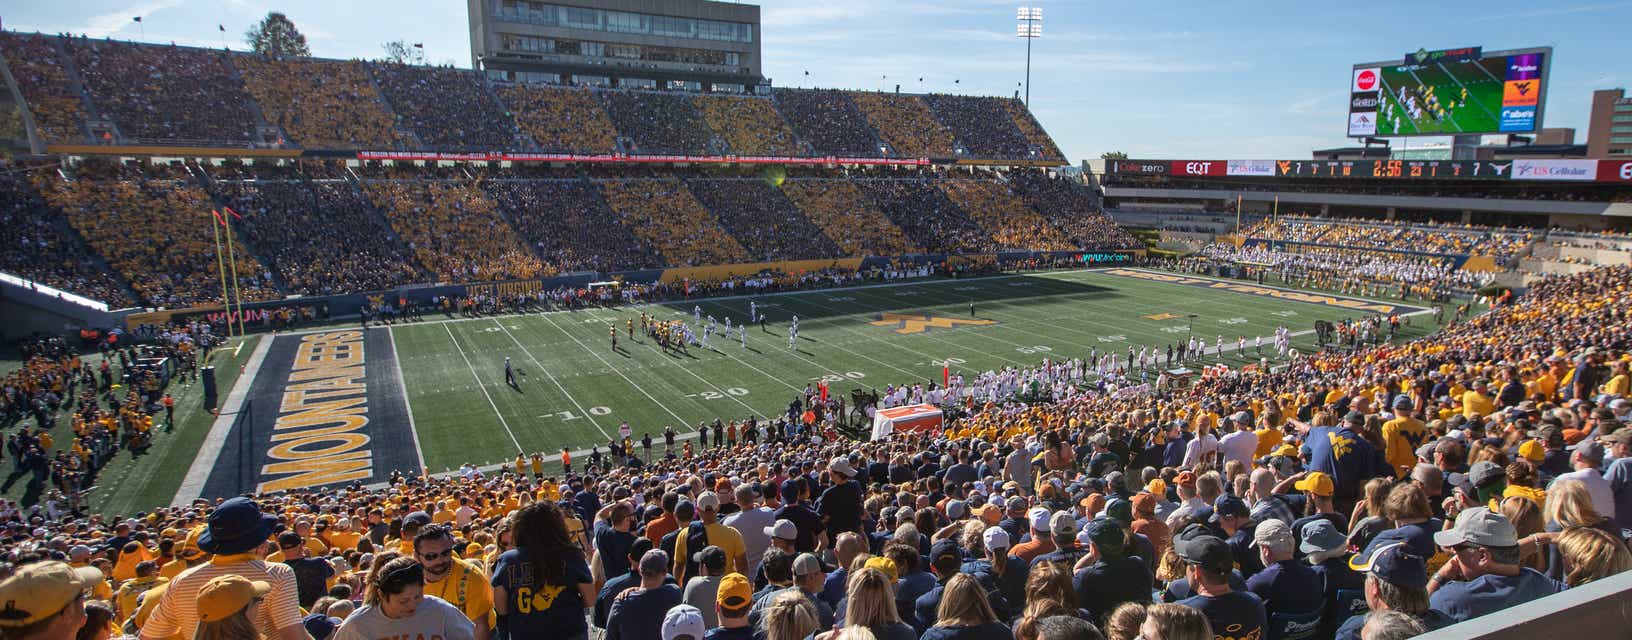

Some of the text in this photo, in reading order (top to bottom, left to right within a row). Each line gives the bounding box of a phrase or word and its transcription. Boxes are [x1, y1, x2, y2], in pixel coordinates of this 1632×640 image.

[1141, 164, 1164, 173] zero
[1186, 161, 1212, 175] EQT
[1533, 165, 1587, 175] US Cellular
[256, 330, 374, 498] MOUNTAINEERS
